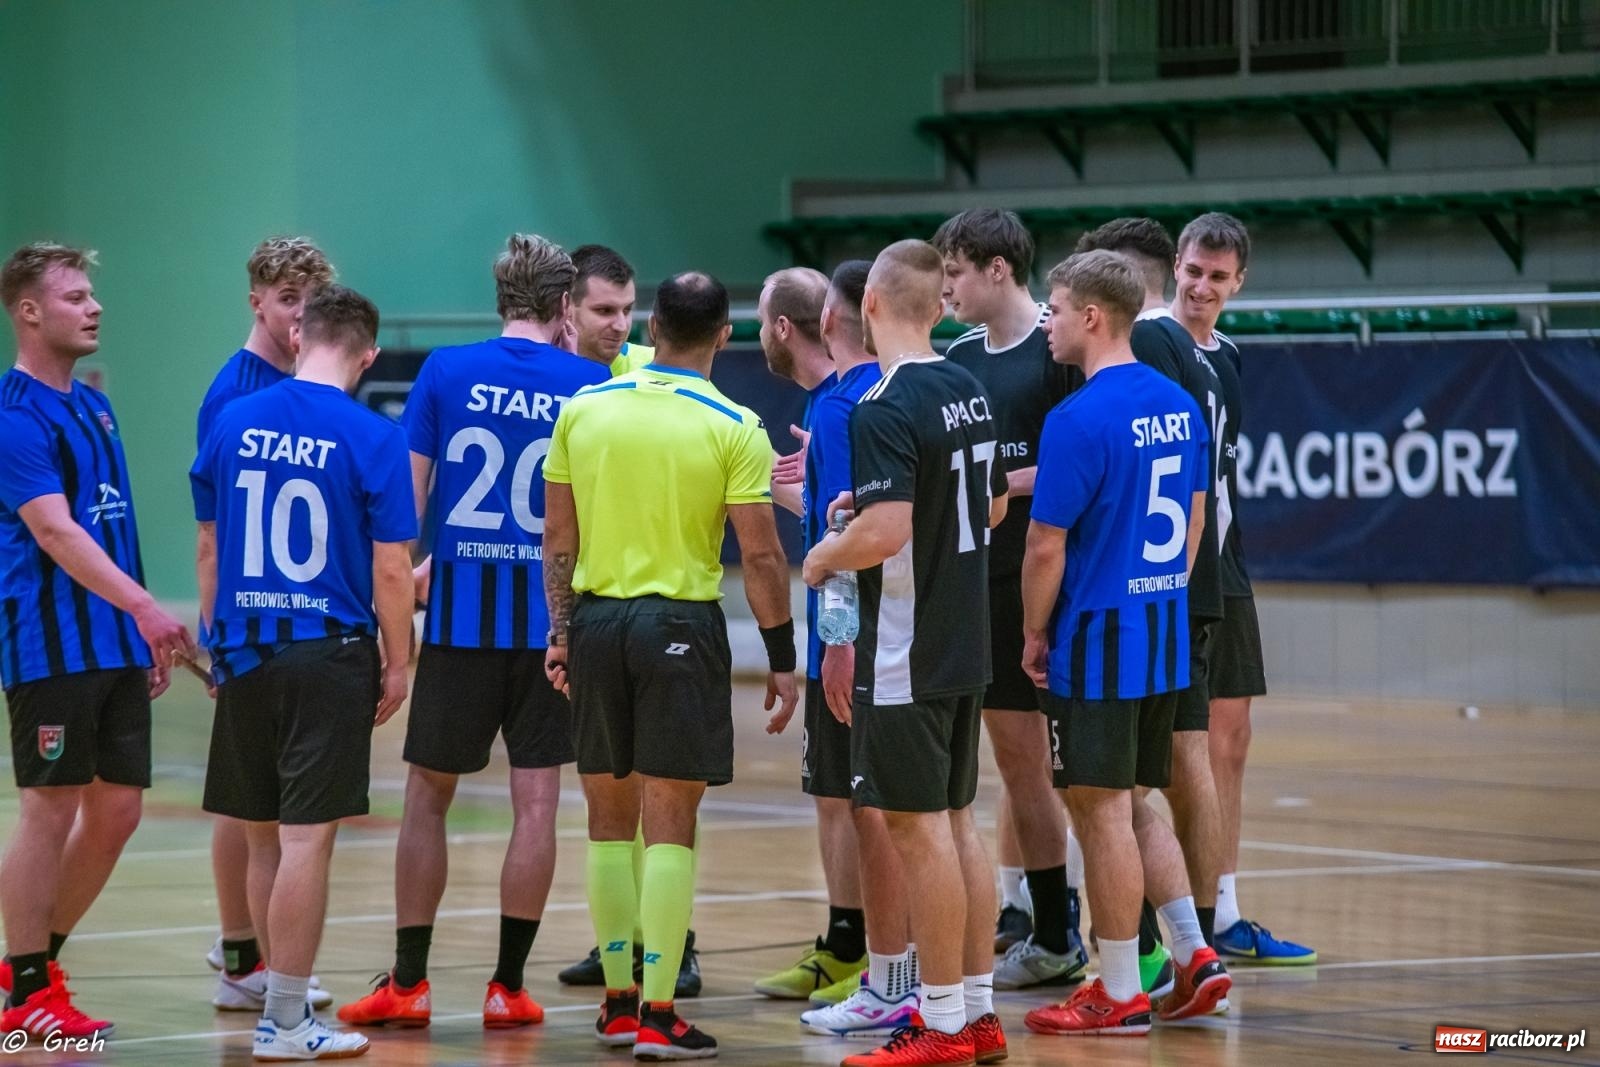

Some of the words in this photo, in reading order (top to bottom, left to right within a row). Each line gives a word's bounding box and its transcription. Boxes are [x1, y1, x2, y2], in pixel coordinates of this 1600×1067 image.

[1131, 411, 1191, 448] START
[238, 428, 337, 470] START
[1236, 407, 1519, 499] RACIBÓRZ
[235, 469, 328, 583] 10
[1142, 454, 1187, 563] 5
[457, 541, 516, 559] PIETROWICE
[236, 591, 290, 609] PIETROWICE
[1128, 574, 1174, 594] PIETROWICE
[1051, 720, 1060, 752] 5
